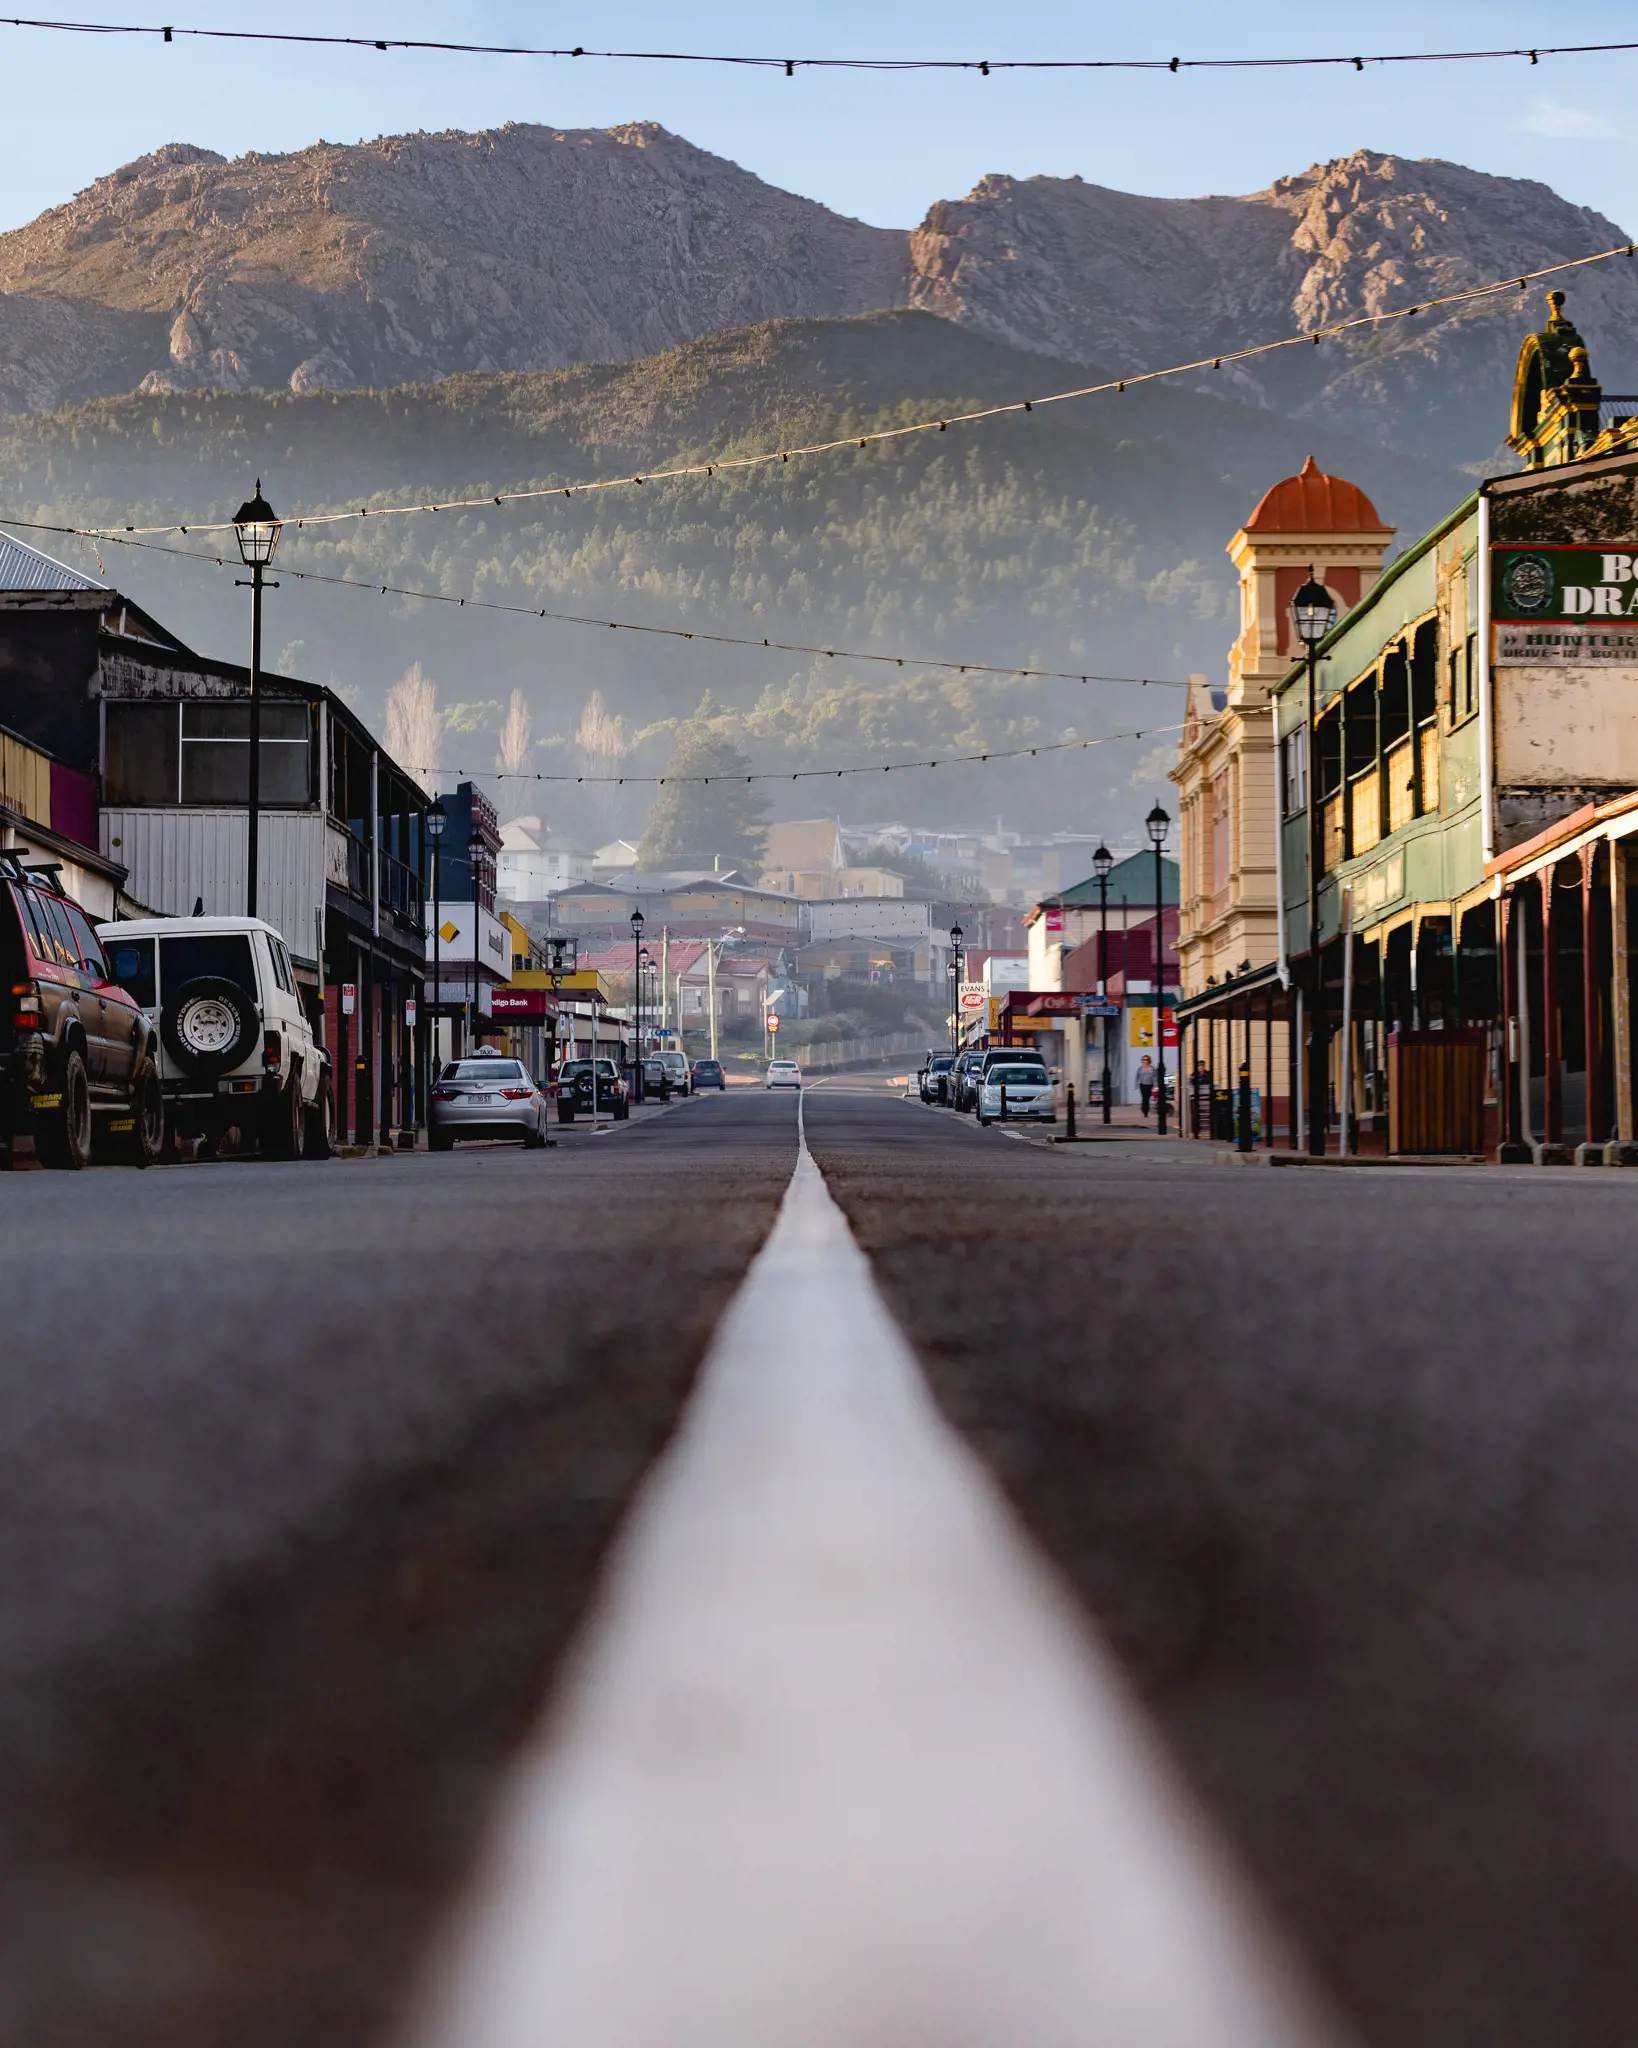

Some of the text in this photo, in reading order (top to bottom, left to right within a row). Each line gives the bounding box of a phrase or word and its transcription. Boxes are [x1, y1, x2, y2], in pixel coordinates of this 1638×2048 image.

[1600, 554, 1638, 583] B
[960, 985, 985, 993] EVANS
[491, 998, 528, 1007] ndigo Bank
[963, 995, 982, 1005] IGA
[218, 996, 241, 1025] DESERT
[176, 997, 199, 1056] BRIDGESTONE
